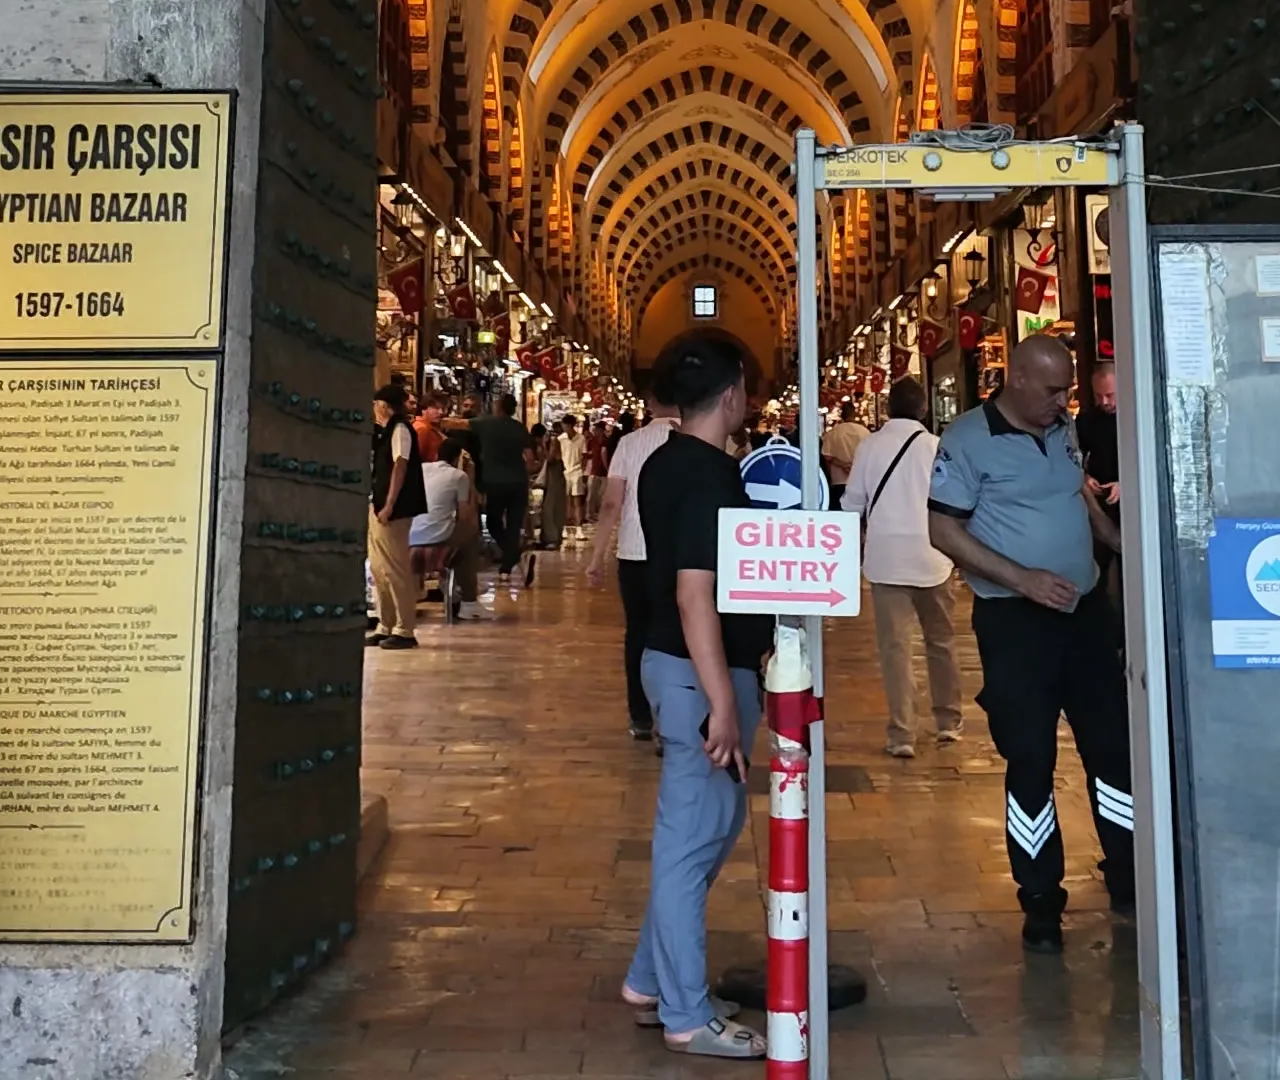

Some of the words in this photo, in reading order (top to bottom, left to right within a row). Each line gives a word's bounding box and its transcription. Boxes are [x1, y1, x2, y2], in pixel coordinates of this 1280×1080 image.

[67, 123, 201, 177] ÇARŞISI
[826, 150, 908, 163] PERKOTEK
[90, 192, 188, 222] BAZAAR
[13, 243, 62, 264] SPICE
[67, 243, 133, 263] BAZAAR
[15, 292, 125, 317] 1597-1664
[8, 379, 86, 393] ÇARŞISININ
[89, 377, 161, 392] TARİHÇESİ
[735, 517, 843, 555] GİRİŞ
[738, 559, 839, 582] ENTRY
